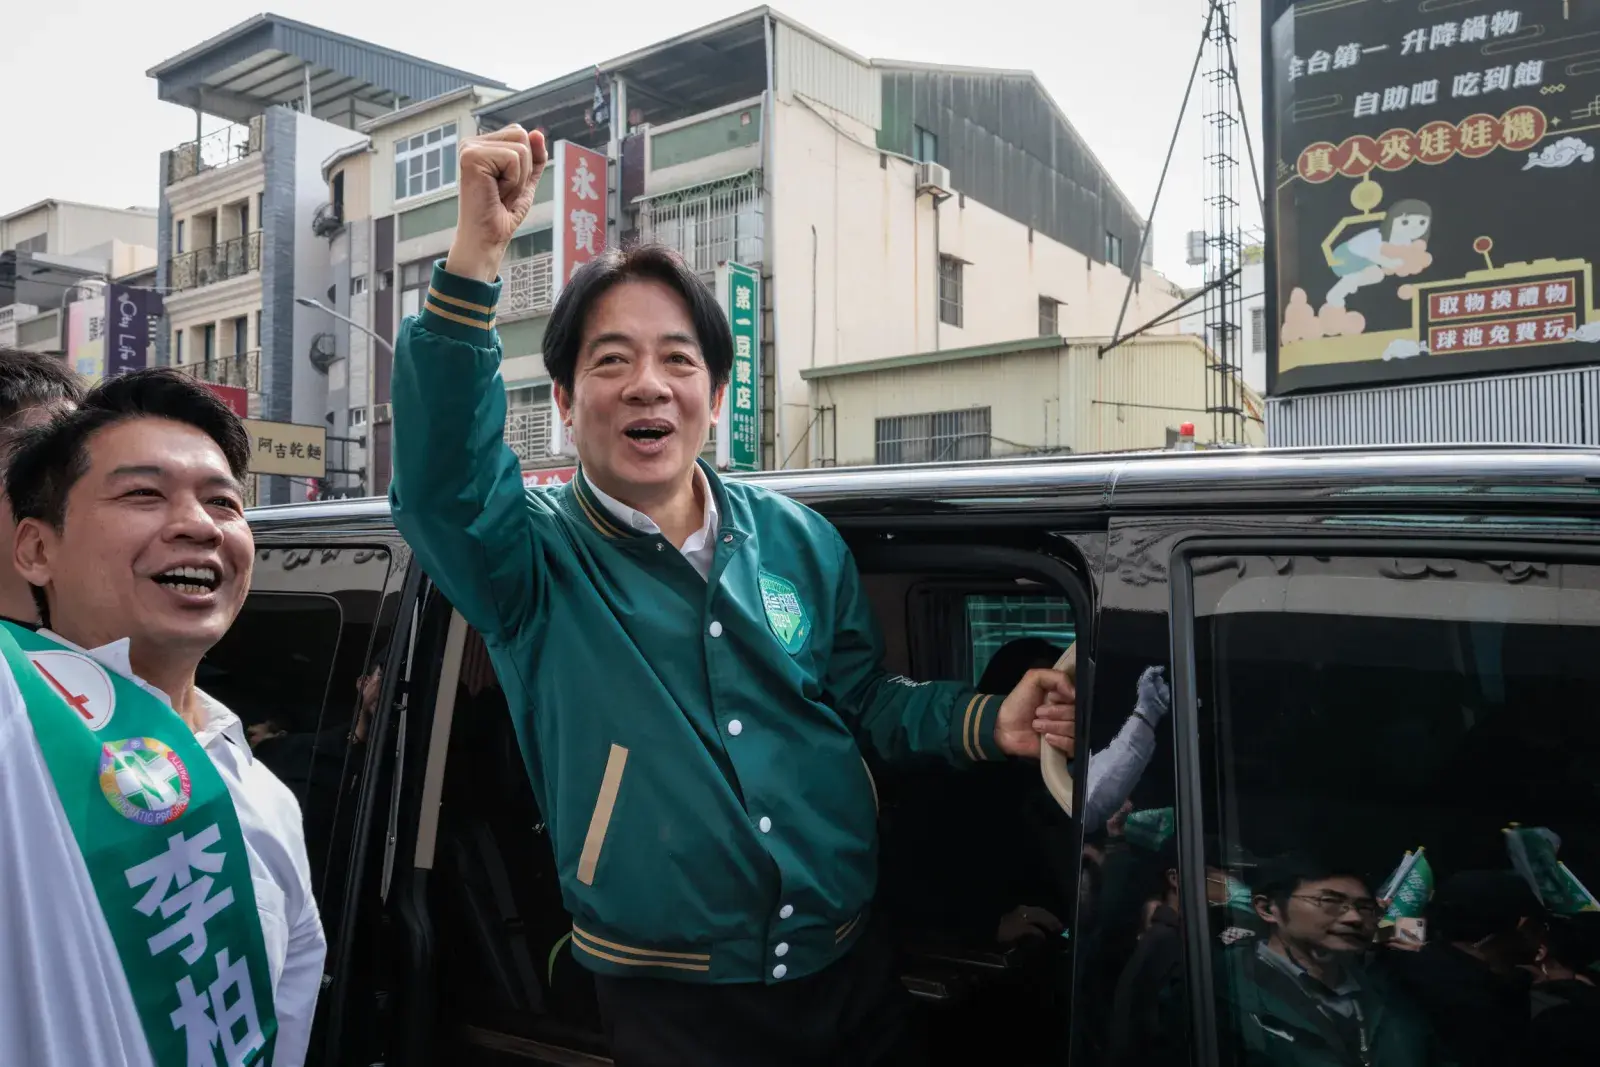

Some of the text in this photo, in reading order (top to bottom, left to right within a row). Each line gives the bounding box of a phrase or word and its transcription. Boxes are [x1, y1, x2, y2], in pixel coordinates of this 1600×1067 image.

[1287, 10, 1522, 82] 全台第一 升降鍋物
[1353, 59, 1544, 118] 自助吧 吃到飽
[1304, 111, 1536, 177] 真人夾娃娃機
[570, 157, 599, 278] 永寶
[1438, 284, 1568, 315] 取物換禮物
[118, 334, 136, 360] Life
[1436, 318, 1565, 350] 球池免費玩
[257, 436, 322, 460] 阿吉乾麵
[124, 822, 266, 1067] 李柏
